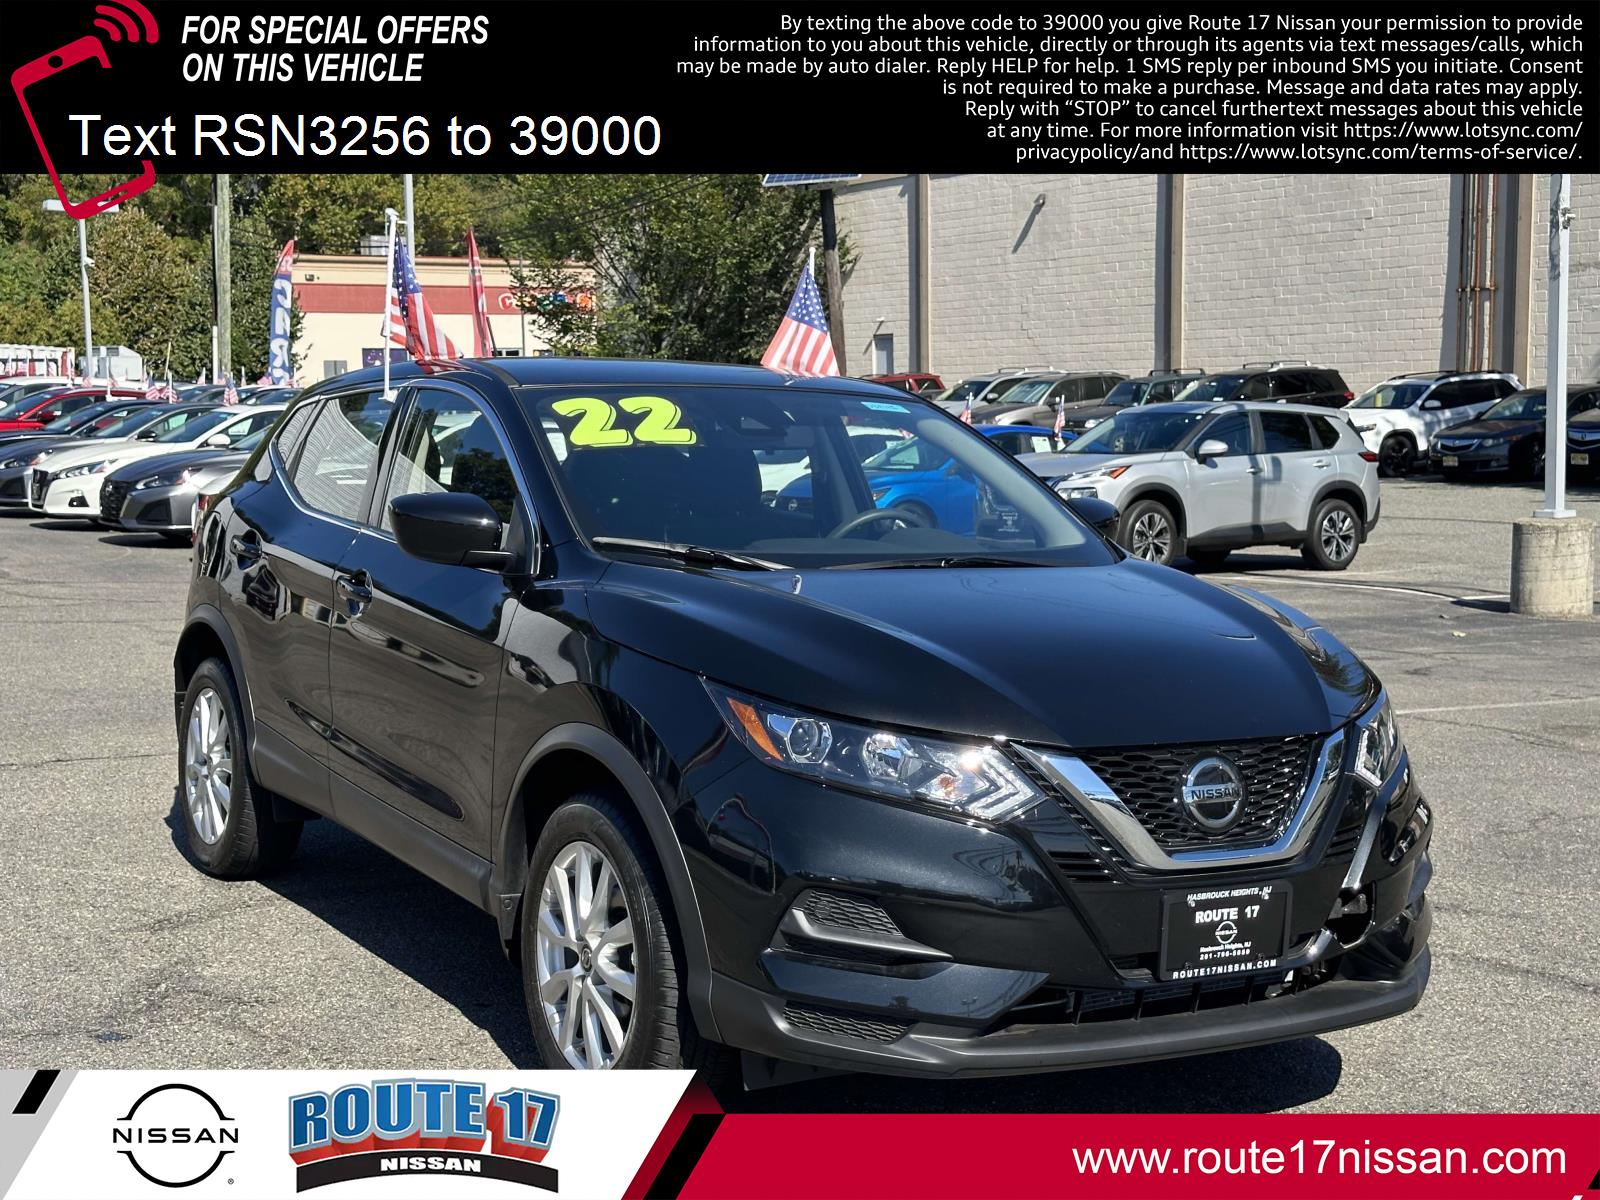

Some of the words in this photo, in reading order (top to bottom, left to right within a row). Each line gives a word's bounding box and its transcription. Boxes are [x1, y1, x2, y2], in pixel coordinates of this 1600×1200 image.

[551, 396, 698, 447] 22
[1191, 787, 1240, 800] NISSAN
[1187, 889, 1230, 901] HASBROUCK
[1195, 907, 1239, 923] ROUTE
[1245, 905, 1260, 918] 17
[1172, 959, 1277, 979] ROUTE17NISSAN.COM
